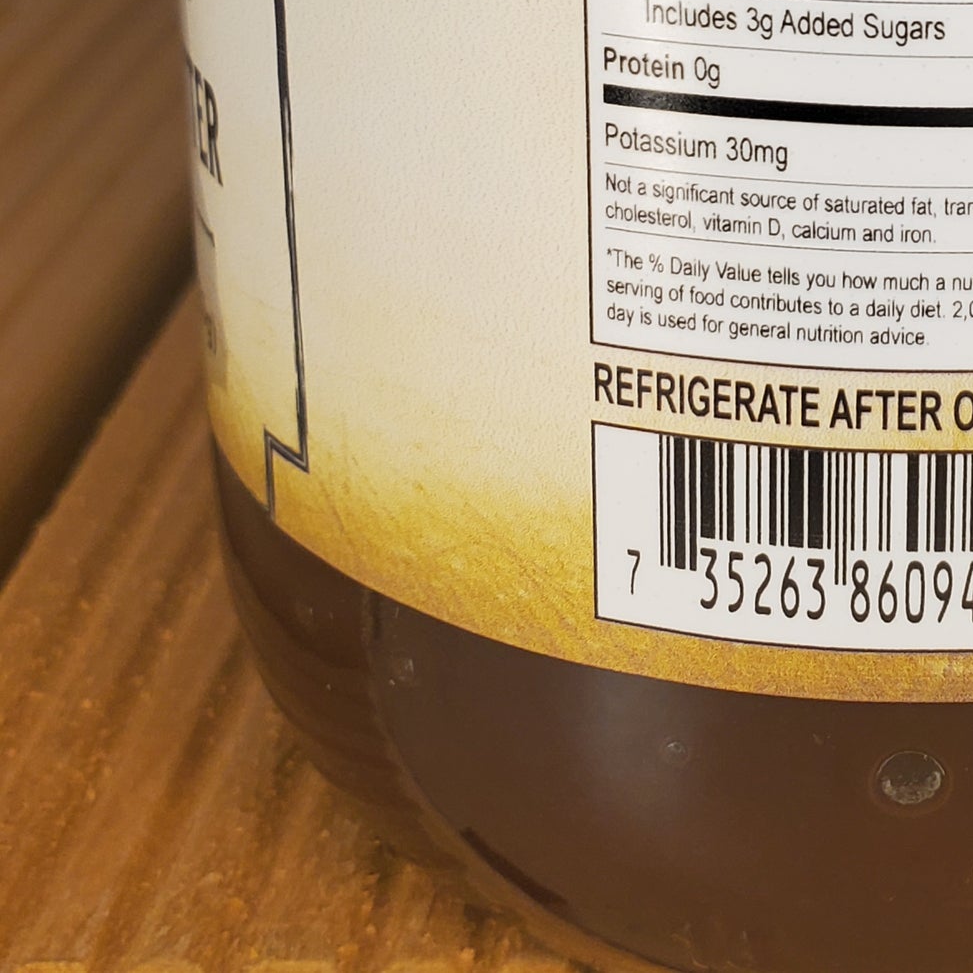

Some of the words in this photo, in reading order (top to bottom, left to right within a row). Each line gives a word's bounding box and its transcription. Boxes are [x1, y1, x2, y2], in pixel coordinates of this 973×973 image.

[747, 7, 773, 40] 3g
[780, 9, 853, 37] Added
[864, 13, 945, 47] Sugars
[604, 47, 684, 80] Protein
[694, 56, 720, 89] 0g
[606, 122, 716, 159] Potassium
[727, 137, 787, 172] 30mg
[606, 173, 631, 194] Not
[638, 182, 646, 195] a
[653, 180, 734, 205] significant
[741, 193, 796, 210] source
[803, 194, 819, 211] of
[825, 196, 904, 215] saturated
[912, 197, 936, 217] fat,
[606, 202, 697, 232] cholesterol,
[703, 213, 761, 234] vitamin
[769, 218, 784, 240] D,
[792, 221, 856, 241] calcium
[863, 225, 893, 242] and
[901, 223, 936, 243] iron.
[649, 254, 663, 272] %
[671, 257, 710, 282] Daily
[716, 262, 761, 282] Value
[768, 267, 800, 285] tells
[807, 274, 835, 291] you
[843, 272, 877, 289] how
[884, 273, 929, 290] much
[936, 277, 945, 290] a
[607, 279, 662, 304] serving
[669, 285, 684, 302] of
[690, 286, 724, 306] food
[730, 294, 822, 314] contributes
[828, 299, 843, 315] to
[850, 303, 859, 316] a
[866, 299, 904, 322] daily
[911, 300, 946, 318] diet.
[607, 303, 634, 327] day
[641, 306, 652, 325] is
[658, 313, 696, 330] used
[703, 315, 723, 333] for
[729, 321, 790, 339] general
[797, 325, 863, 343] nutrition
[870, 327, 929, 345] advice.
[593, 361, 821, 428] REFRIGERATE
[829, 388, 942, 431] AFTER
[627, 549, 640, 595] 7
[698, 548, 827, 620] 35263
